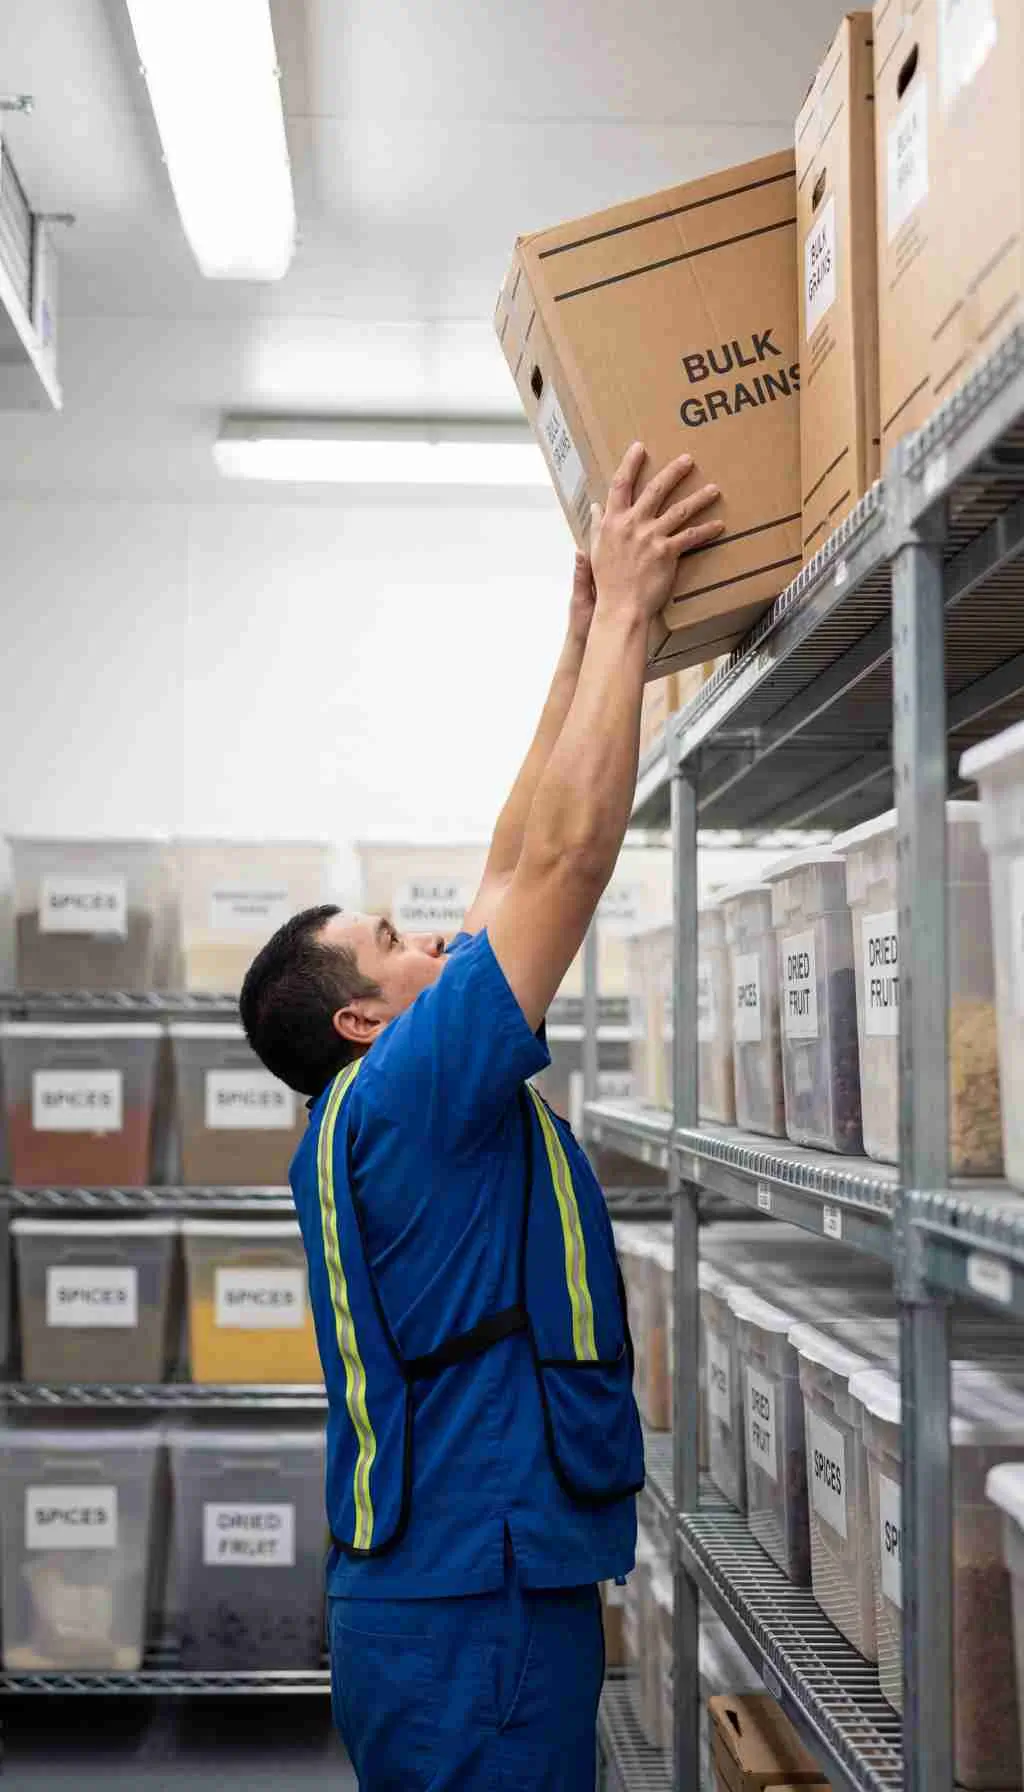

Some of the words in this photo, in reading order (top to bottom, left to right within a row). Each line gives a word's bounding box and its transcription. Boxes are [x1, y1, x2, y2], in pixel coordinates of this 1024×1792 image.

[682, 328, 782, 384] BULK
[868, 935, 898, 968] DRIED
[788, 951, 810, 982] DRIED
[789, 989, 810, 1017] FRUIT
[871, 978, 898, 1008] FRUIT
[42, 1088, 112, 1109] SPICES
[217, 1088, 286, 1108] SPICES
[57, 1286, 128, 1305] SPICES
[225, 1288, 294, 1307] SPICES
[752, 1387, 770, 1421] DRIED
[752, 1421, 770, 1456] FRUIT
[814, 1450, 842, 1496] SPICES
[35, 1507, 107, 1527] SPICES
[216, 1512, 282, 1531] DRIED
[218, 1537, 278, 1557] FRUIT
